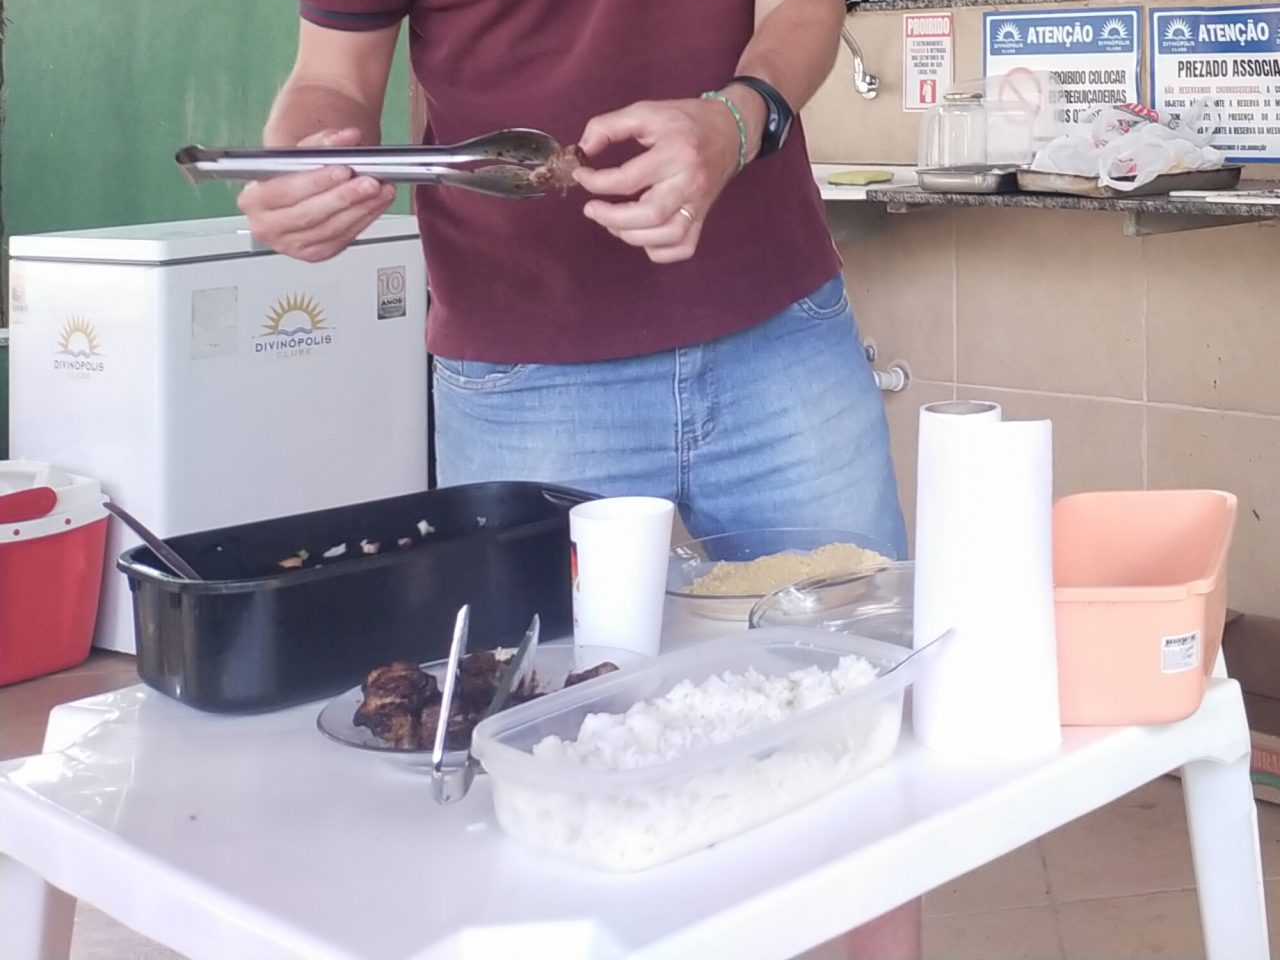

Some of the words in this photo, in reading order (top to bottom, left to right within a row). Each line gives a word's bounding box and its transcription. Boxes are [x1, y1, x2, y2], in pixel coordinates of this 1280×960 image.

[907, 18, 950, 35] PROIBIDO
[1027, 22, 1094, 47] ATENÇÃO
[1198, 19, 1270, 46] ATENÇÃO
[1088, 70, 1126, 84] COLOCAR
[1178, 60, 1228, 78] PREZADO
[378, 271, 405, 296] 10
